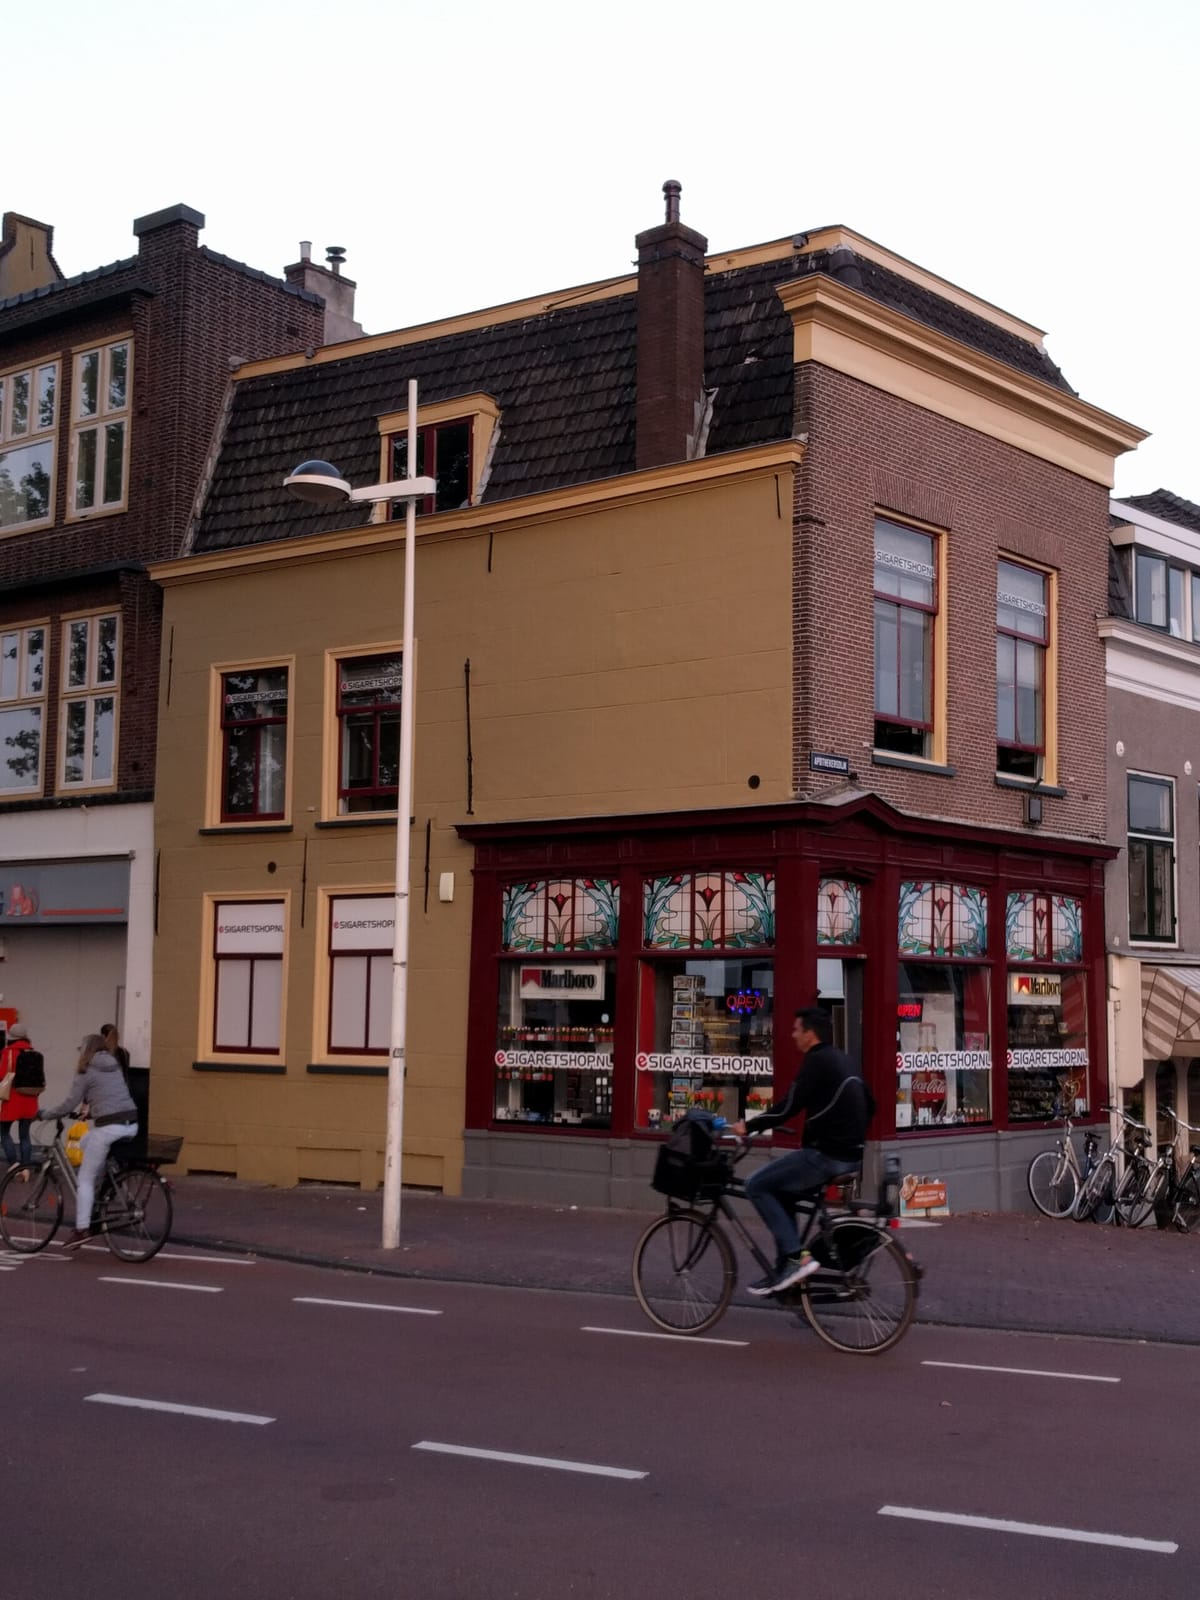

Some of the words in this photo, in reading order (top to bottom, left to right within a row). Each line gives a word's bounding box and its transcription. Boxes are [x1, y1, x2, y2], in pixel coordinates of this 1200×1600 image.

[541, 969, 596, 988] Marlboro
[727, 995, 764, 1009] OPEN
[898, 1004, 921, 1016] OPEN
